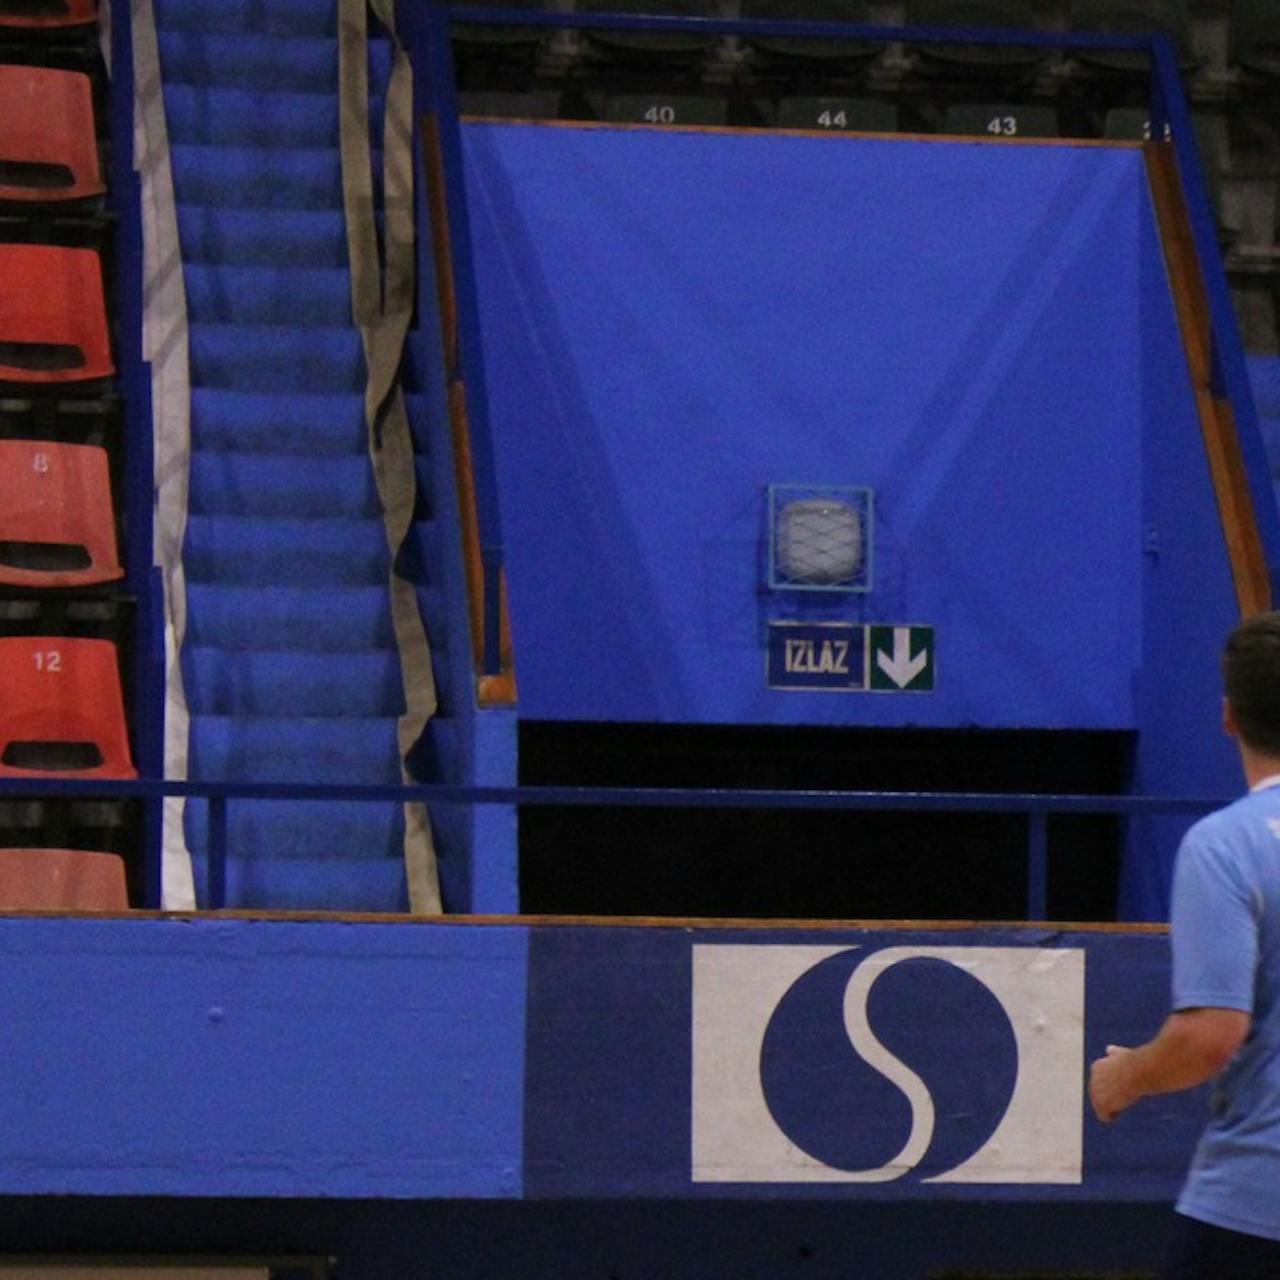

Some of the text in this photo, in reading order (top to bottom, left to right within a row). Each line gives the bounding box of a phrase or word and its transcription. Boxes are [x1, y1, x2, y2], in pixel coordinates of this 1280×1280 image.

[645, 106, 675, 123] 40
[818, 109, 848, 128] 44
[988, 116, 1017, 135] 43
[33, 650, 62, 672] 12
[785, 639, 850, 674] IZLAZ
